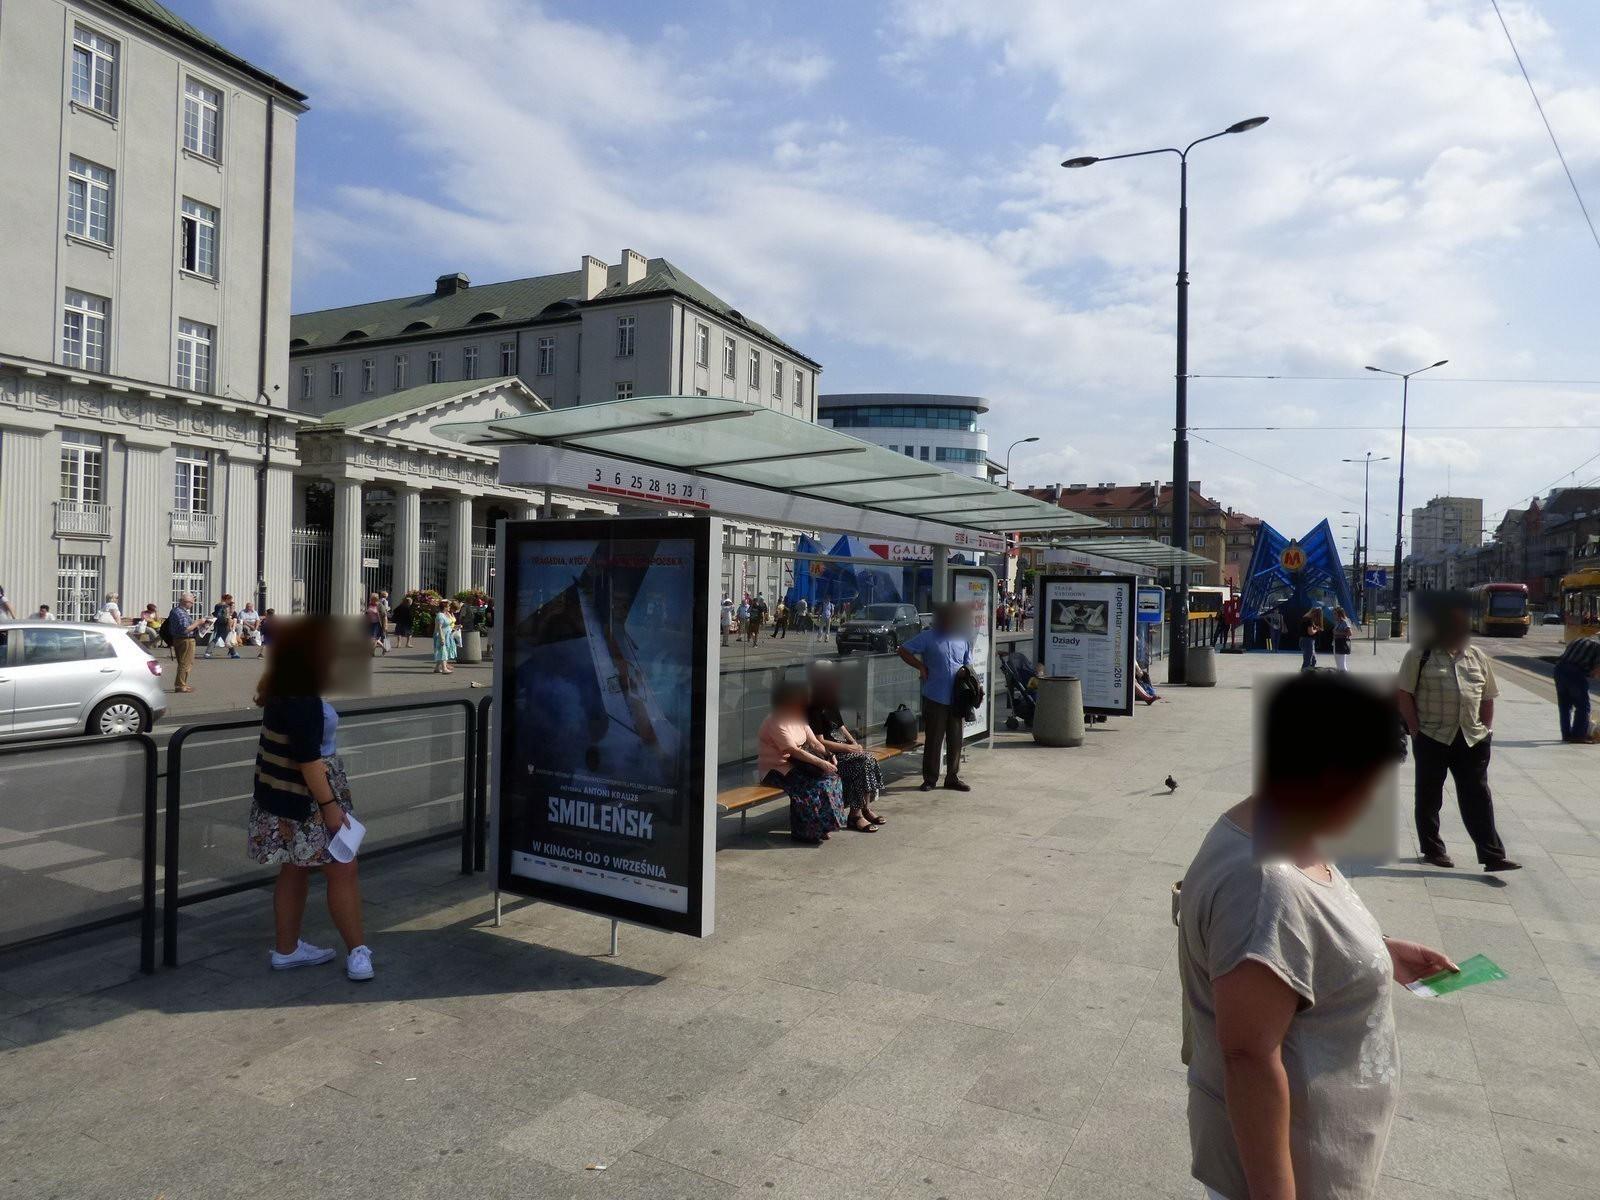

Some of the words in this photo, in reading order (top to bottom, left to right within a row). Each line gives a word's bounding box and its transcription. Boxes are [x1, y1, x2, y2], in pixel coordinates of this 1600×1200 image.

[595, 469, 602, 482] 3
[614, 472, 621, 485] 6
[631, 476, 643, 489] 25
[648, 479, 660, 492] 28
[666, 483, 676, 495] 13
[682, 485, 693, 498] 73
[1115, 587, 1123, 628] repertuar
[1052, 636, 1081, 646] Dziady
[583, 786, 610, 798] ANTONI
[611, 788, 639, 802] KRAUZE
[547, 796, 654, 840] SMOLEŃSK
[532, 840, 541, 852] W
[543, 843, 583, 861] KINACH
[585, 851, 601, 865] OD
[603, 855, 610, 866] 9
[612, 857, 667, 879] WRZEŚNIA
